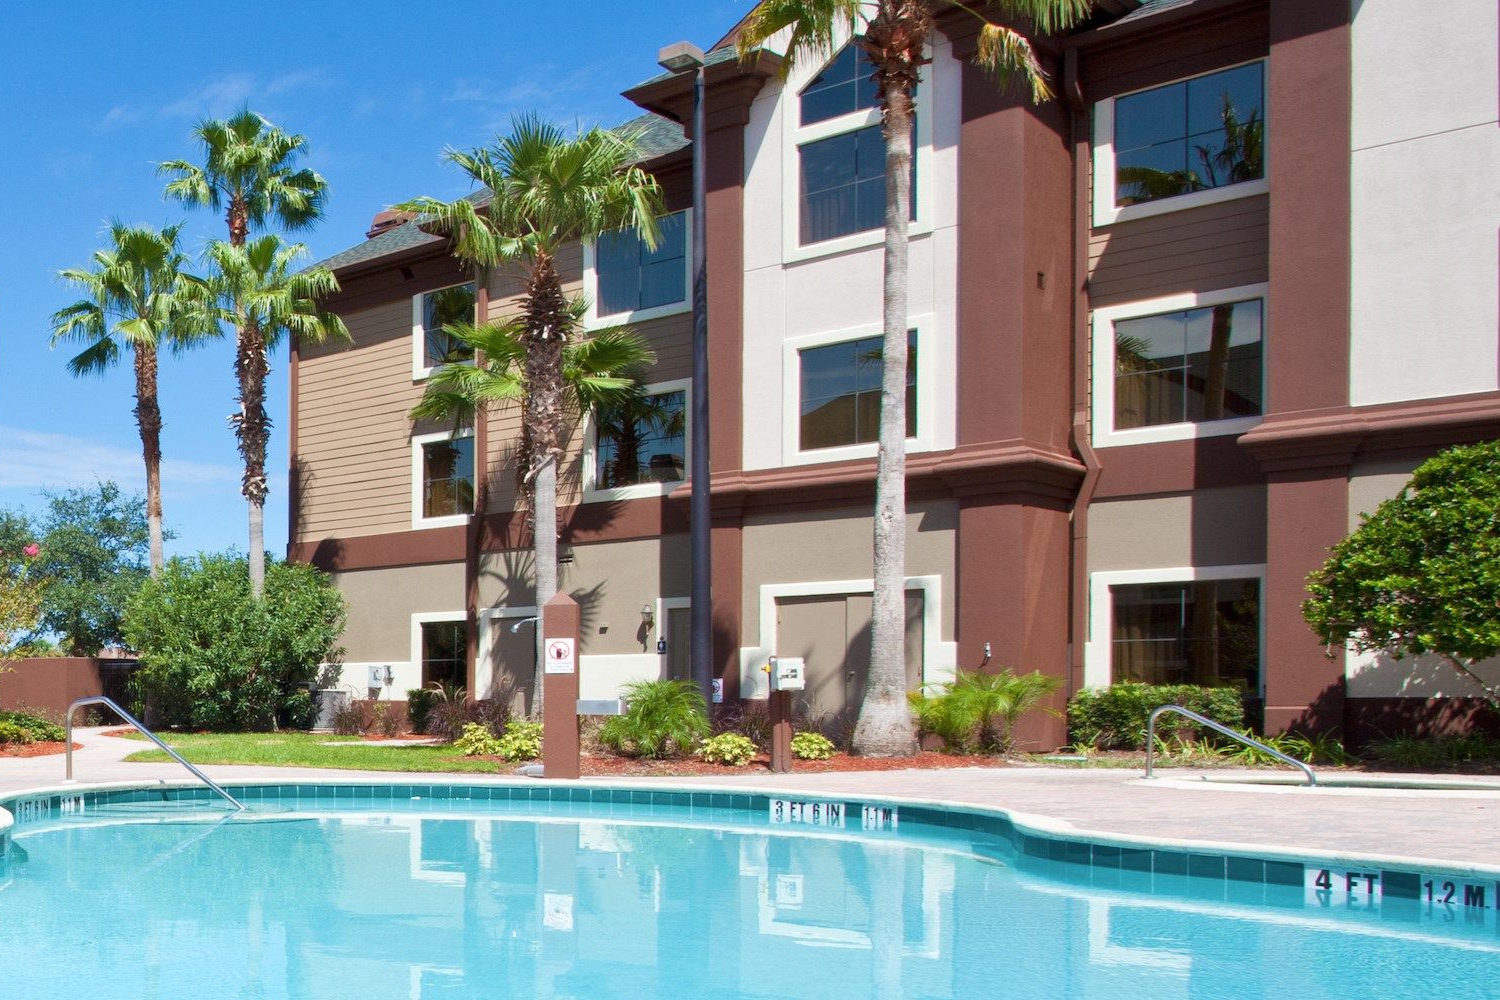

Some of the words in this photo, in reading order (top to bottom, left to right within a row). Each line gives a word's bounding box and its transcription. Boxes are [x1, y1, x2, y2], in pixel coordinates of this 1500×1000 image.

[775, 800, 783, 814] 3
[790, 801, 806, 814] FT
[813, 803, 820, 815] 6
[826, 803, 840, 816] IN
[1314, 869, 1332, 890] 4
[1346, 871, 1379, 895] FT
[1424, 880, 1455, 904] 1.2
[1464, 884, 1490, 908] M.
